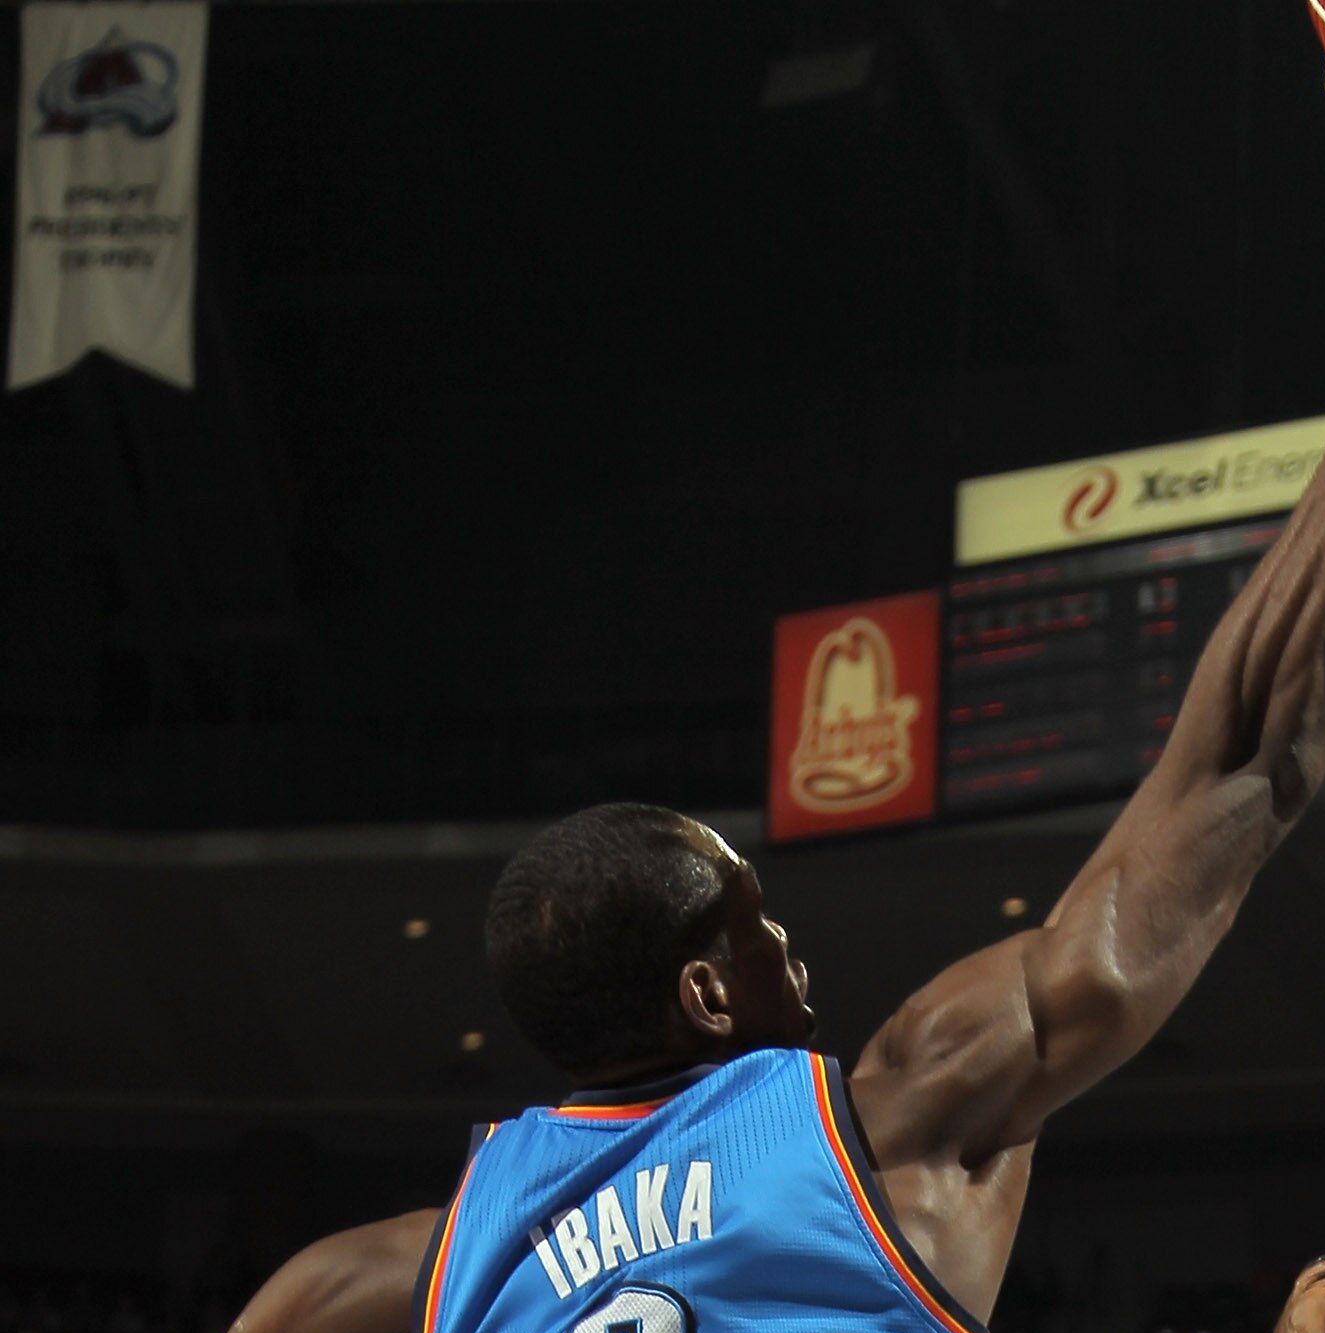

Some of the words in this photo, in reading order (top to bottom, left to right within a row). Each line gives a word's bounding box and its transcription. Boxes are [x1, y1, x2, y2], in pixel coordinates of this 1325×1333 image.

[1137, 457, 1228, 502] Xcel
[1234, 446, 1325, 488] Ener
[529, 1160, 713, 1299] IBAKA
